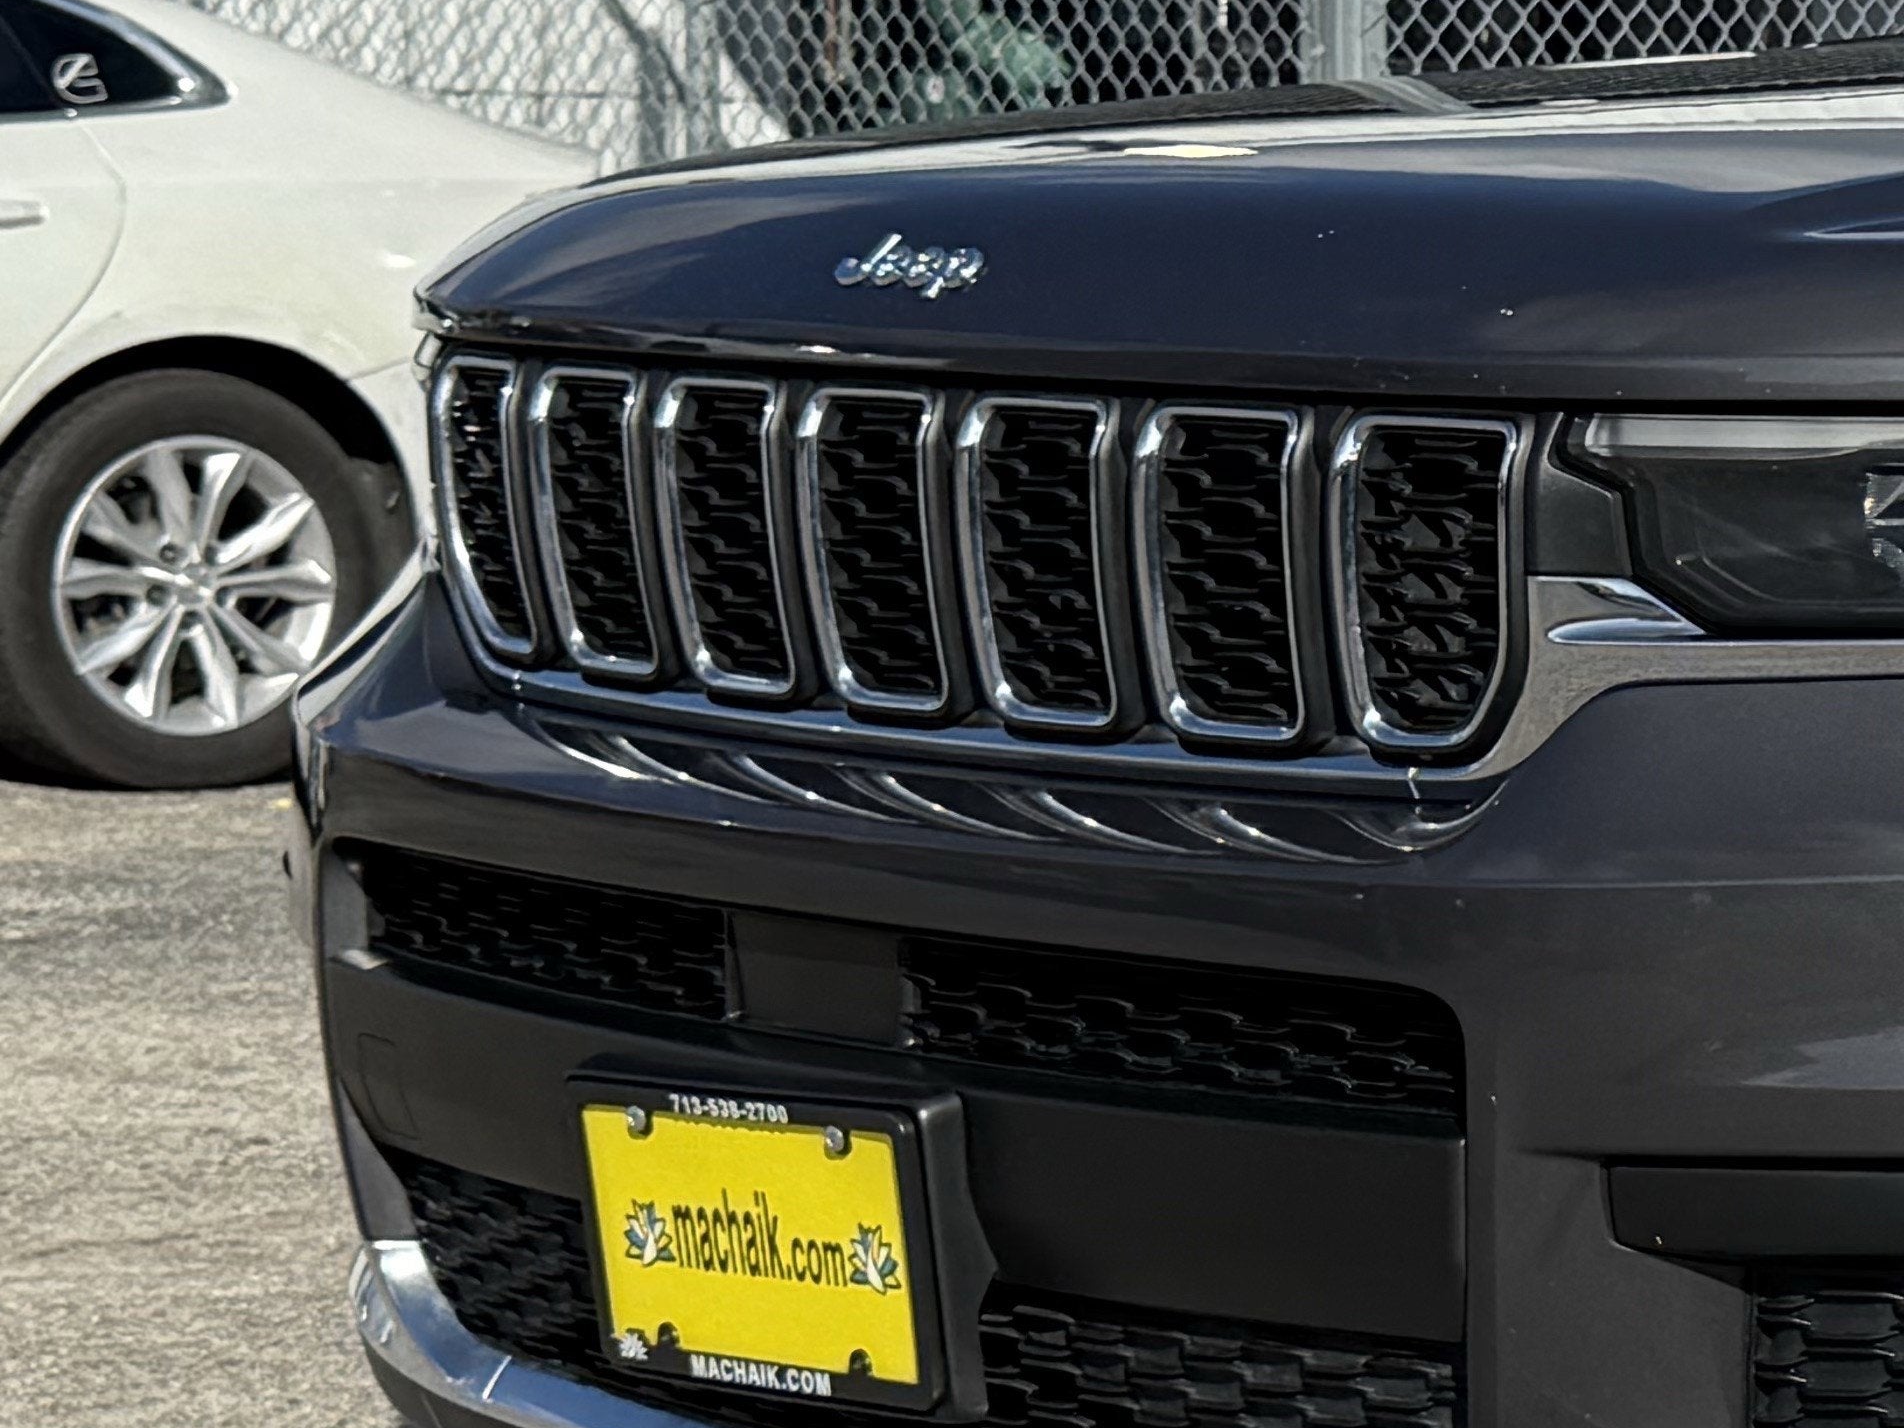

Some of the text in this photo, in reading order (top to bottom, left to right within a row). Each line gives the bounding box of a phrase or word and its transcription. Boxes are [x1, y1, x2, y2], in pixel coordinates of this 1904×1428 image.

[835, 233, 985, 300] Jeep
[671, 1188, 849, 1288] machaik.com
[690, 1354, 832, 1397] MACHAIK.COM
